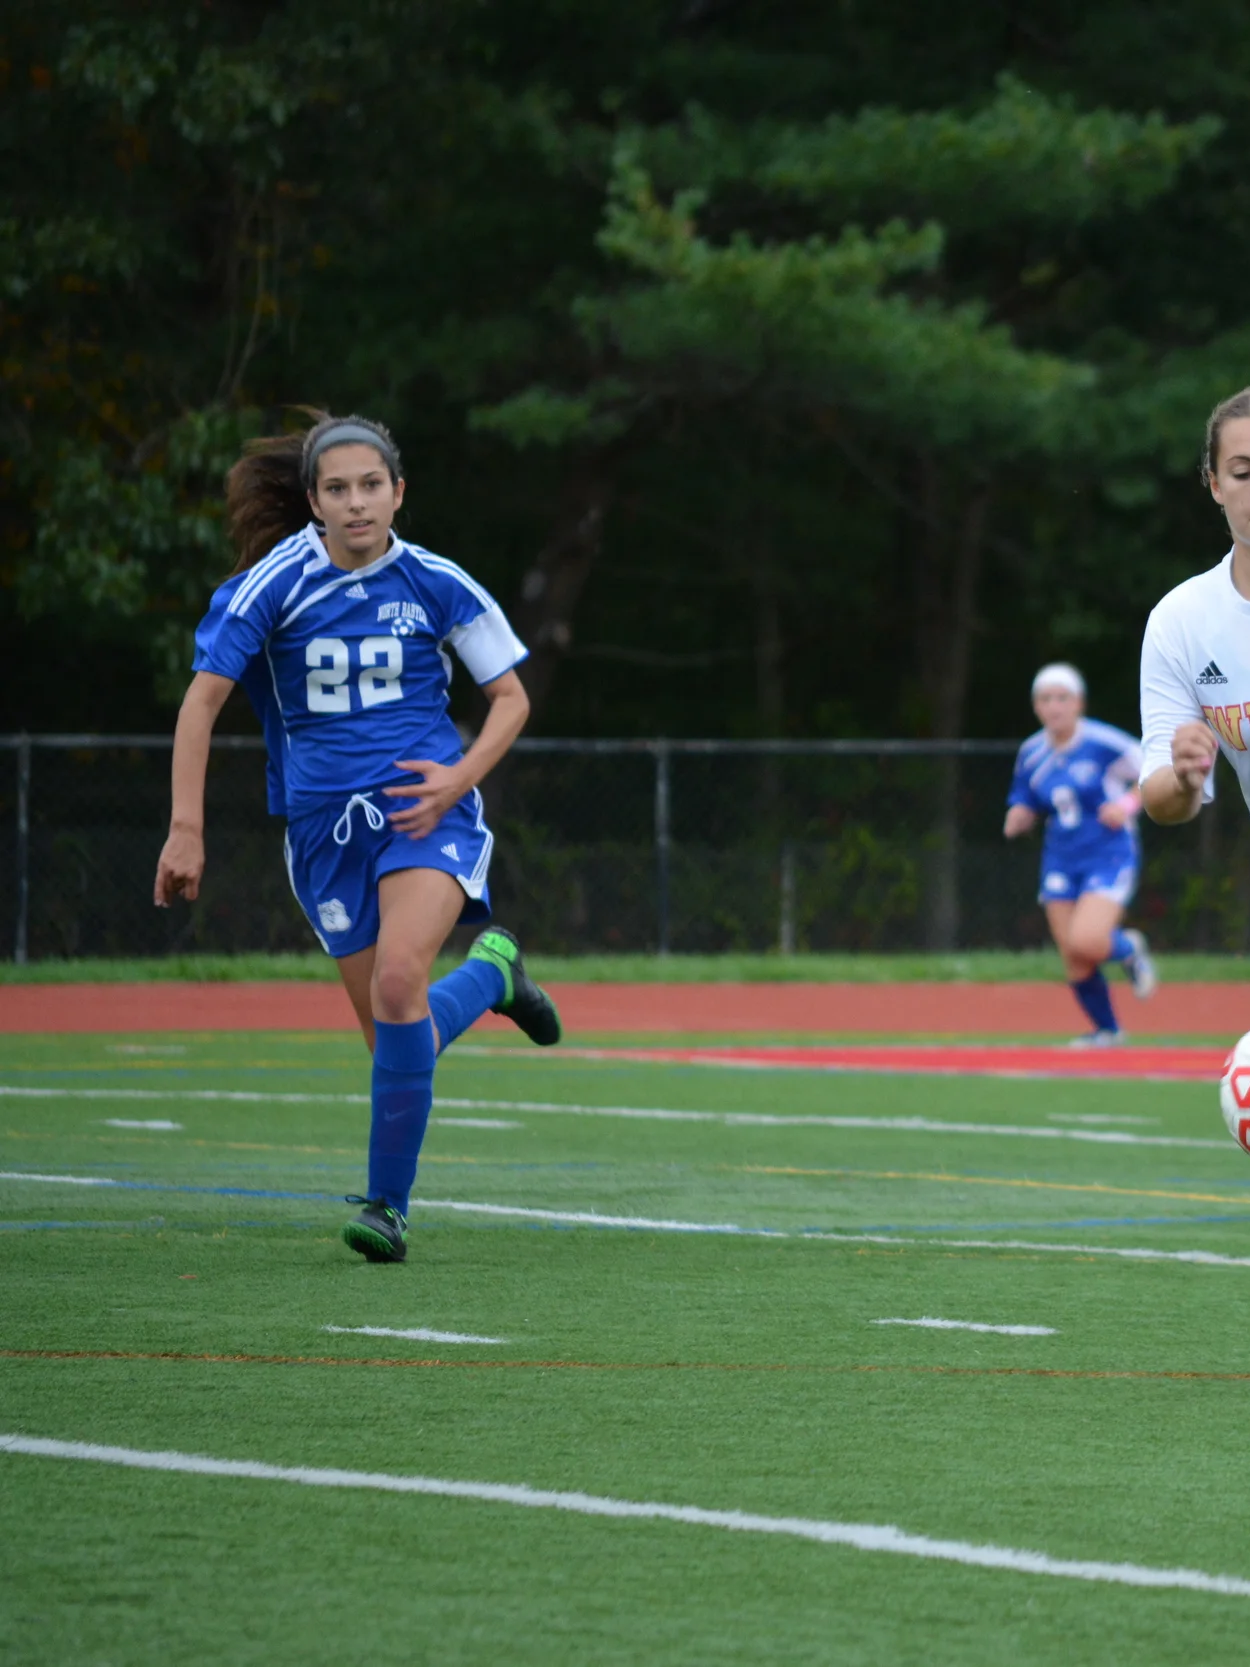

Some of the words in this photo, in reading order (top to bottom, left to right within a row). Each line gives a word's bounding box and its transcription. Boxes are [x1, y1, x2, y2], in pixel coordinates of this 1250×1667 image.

[401, 601, 429, 628] BABYL
[306, 636, 403, 712] 22
[1195, 676, 1228, 685] adidas
